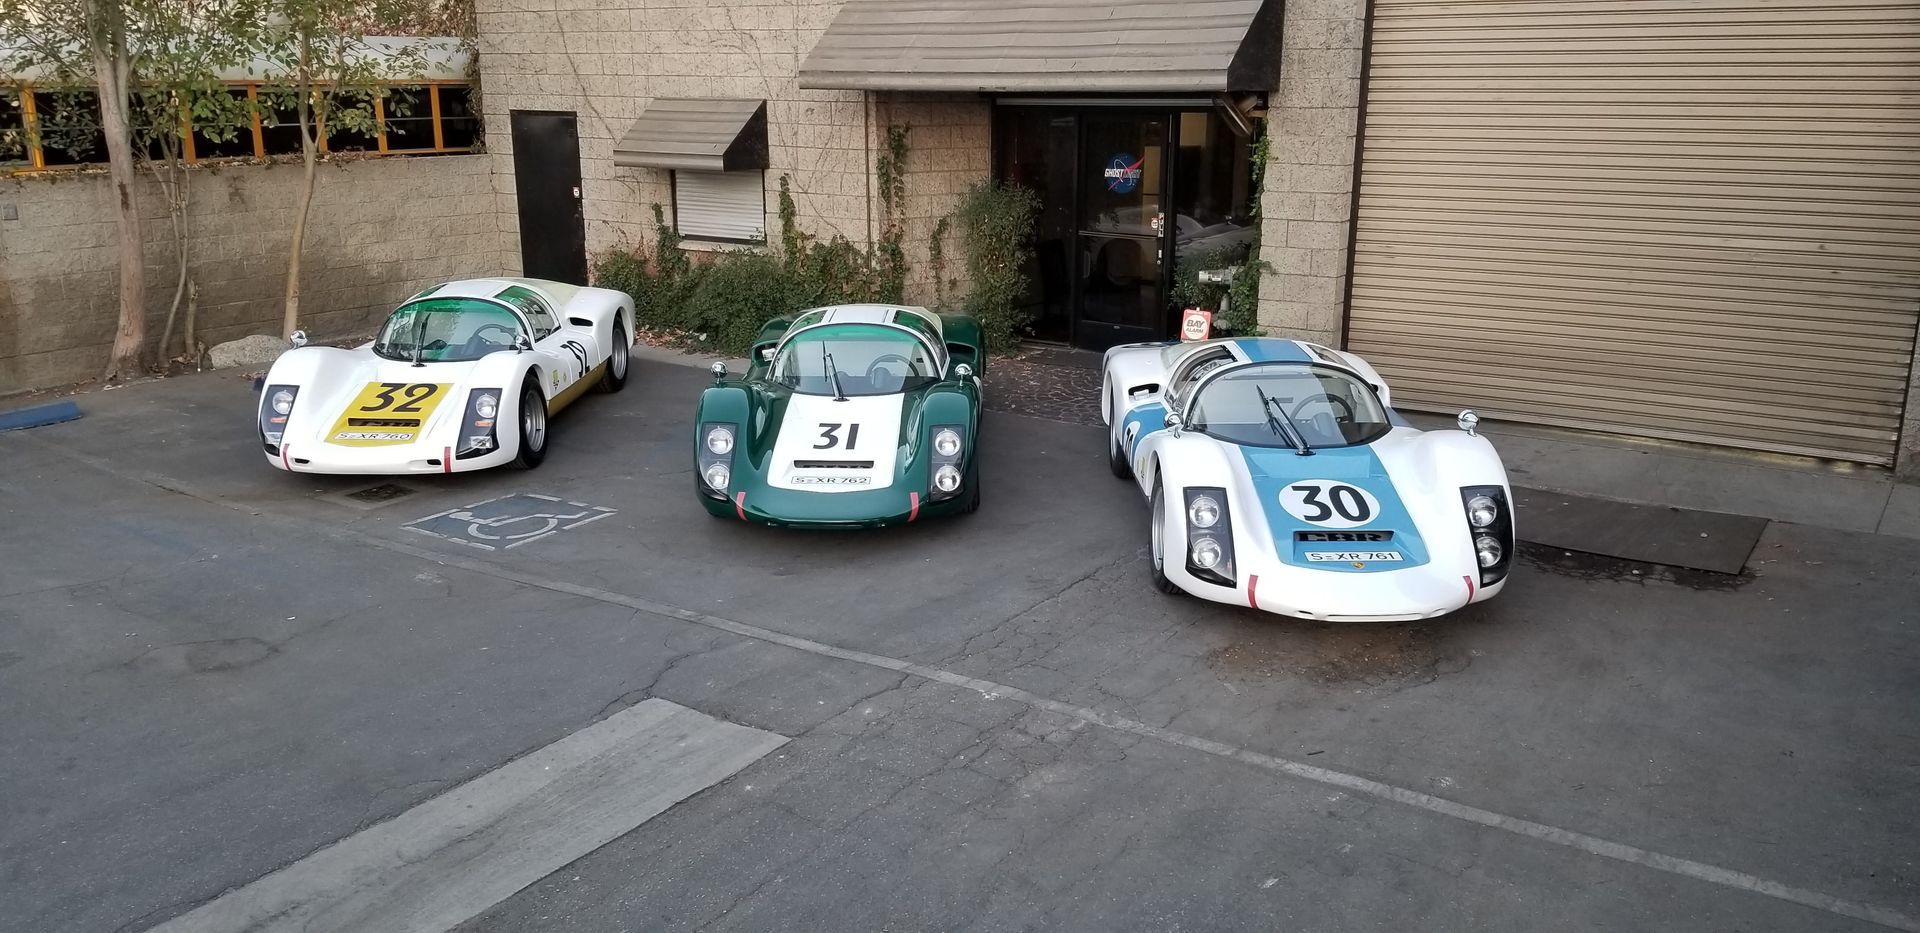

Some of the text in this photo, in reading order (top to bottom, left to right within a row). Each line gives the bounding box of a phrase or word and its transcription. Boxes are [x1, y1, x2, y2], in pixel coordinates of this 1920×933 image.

[1186, 319, 1205, 329] BAY
[359, 382, 438, 412] 32
[812, 422, 860, 450] 31
[1290, 485, 1371, 522] 30
[1367, 552, 1396, 560] 761
